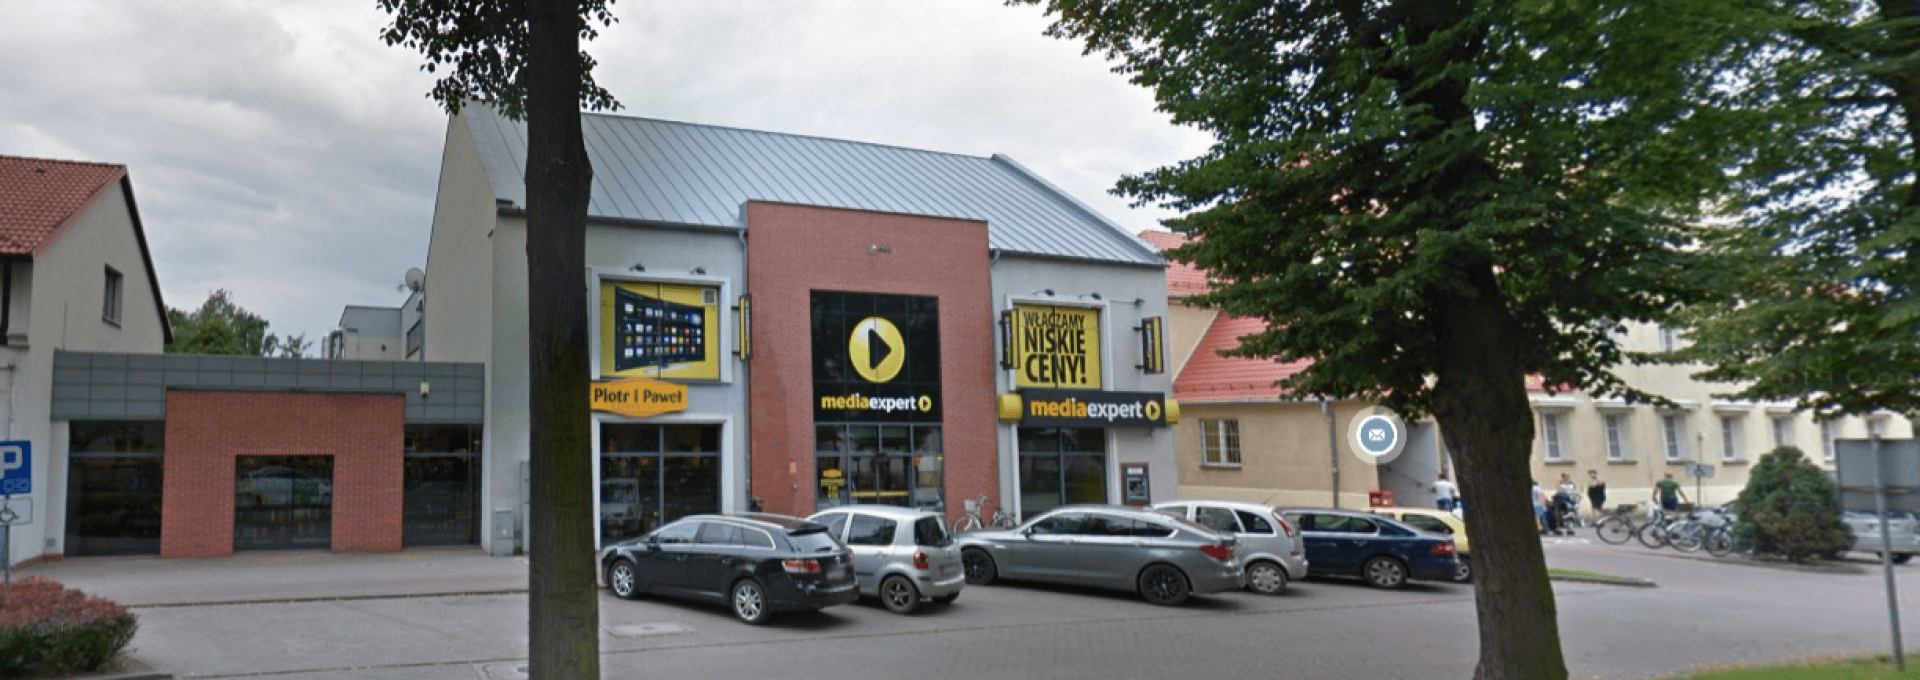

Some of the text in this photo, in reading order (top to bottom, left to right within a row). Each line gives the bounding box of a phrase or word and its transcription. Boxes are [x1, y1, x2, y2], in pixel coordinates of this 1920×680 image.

[1024, 327, 1086, 353] NISKIE
[1025, 354, 1087, 384] CENY!
[594, 387, 630, 403] Piotr
[821, 391, 917, 414] mediaexpert
[1030, 397, 1144, 422] mediaexpert
[0, 446, 23, 480] P
